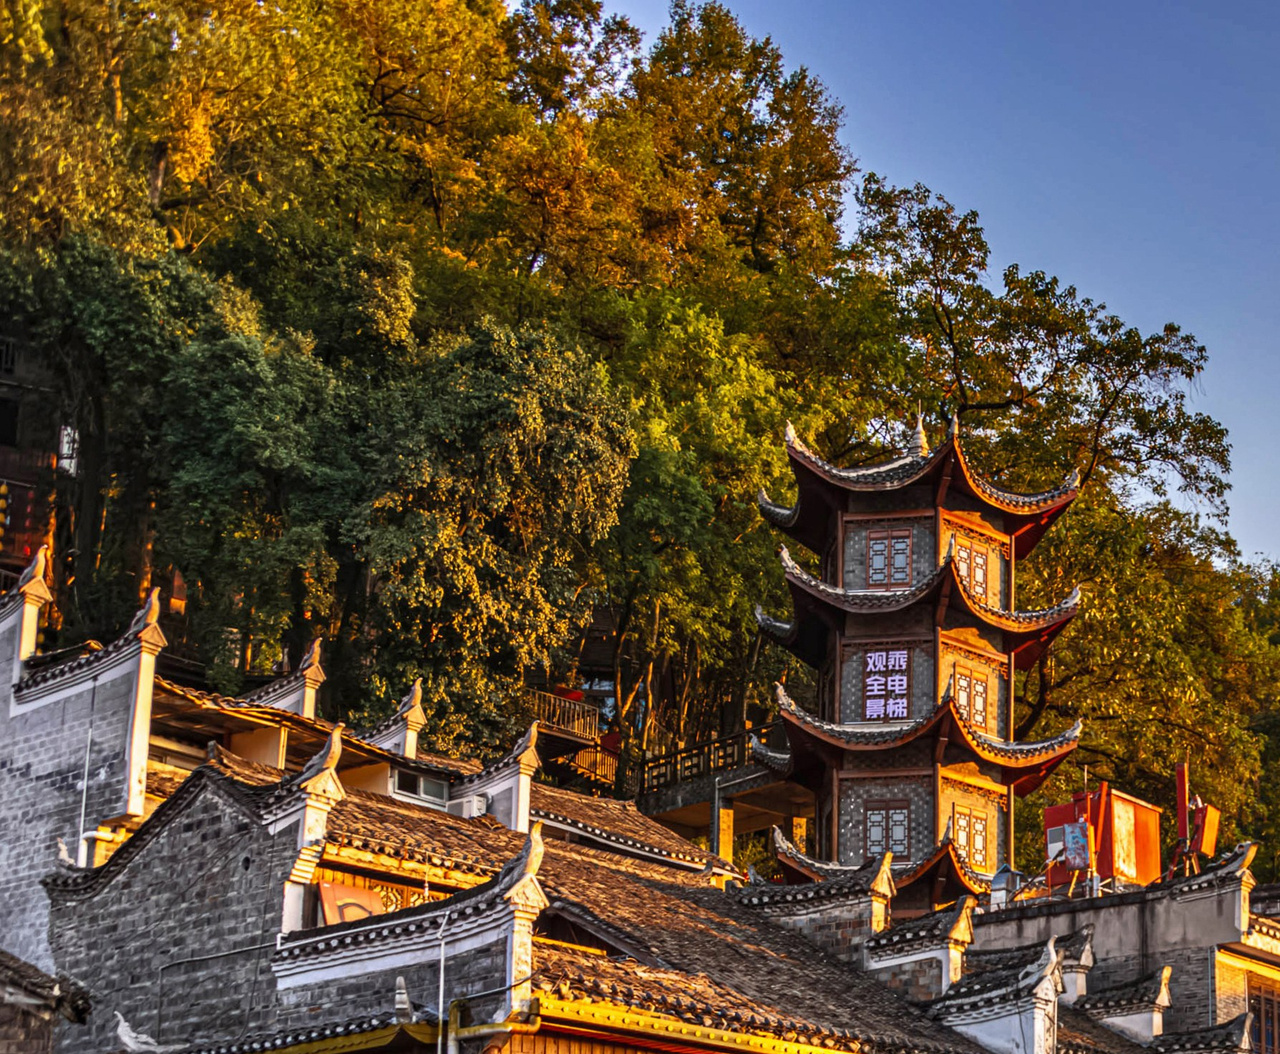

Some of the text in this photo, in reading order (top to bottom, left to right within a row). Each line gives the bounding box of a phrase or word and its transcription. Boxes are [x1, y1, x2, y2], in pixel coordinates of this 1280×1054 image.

[866, 651, 887, 719] 观全景
[887, 651, 907, 718] 乘电梯
